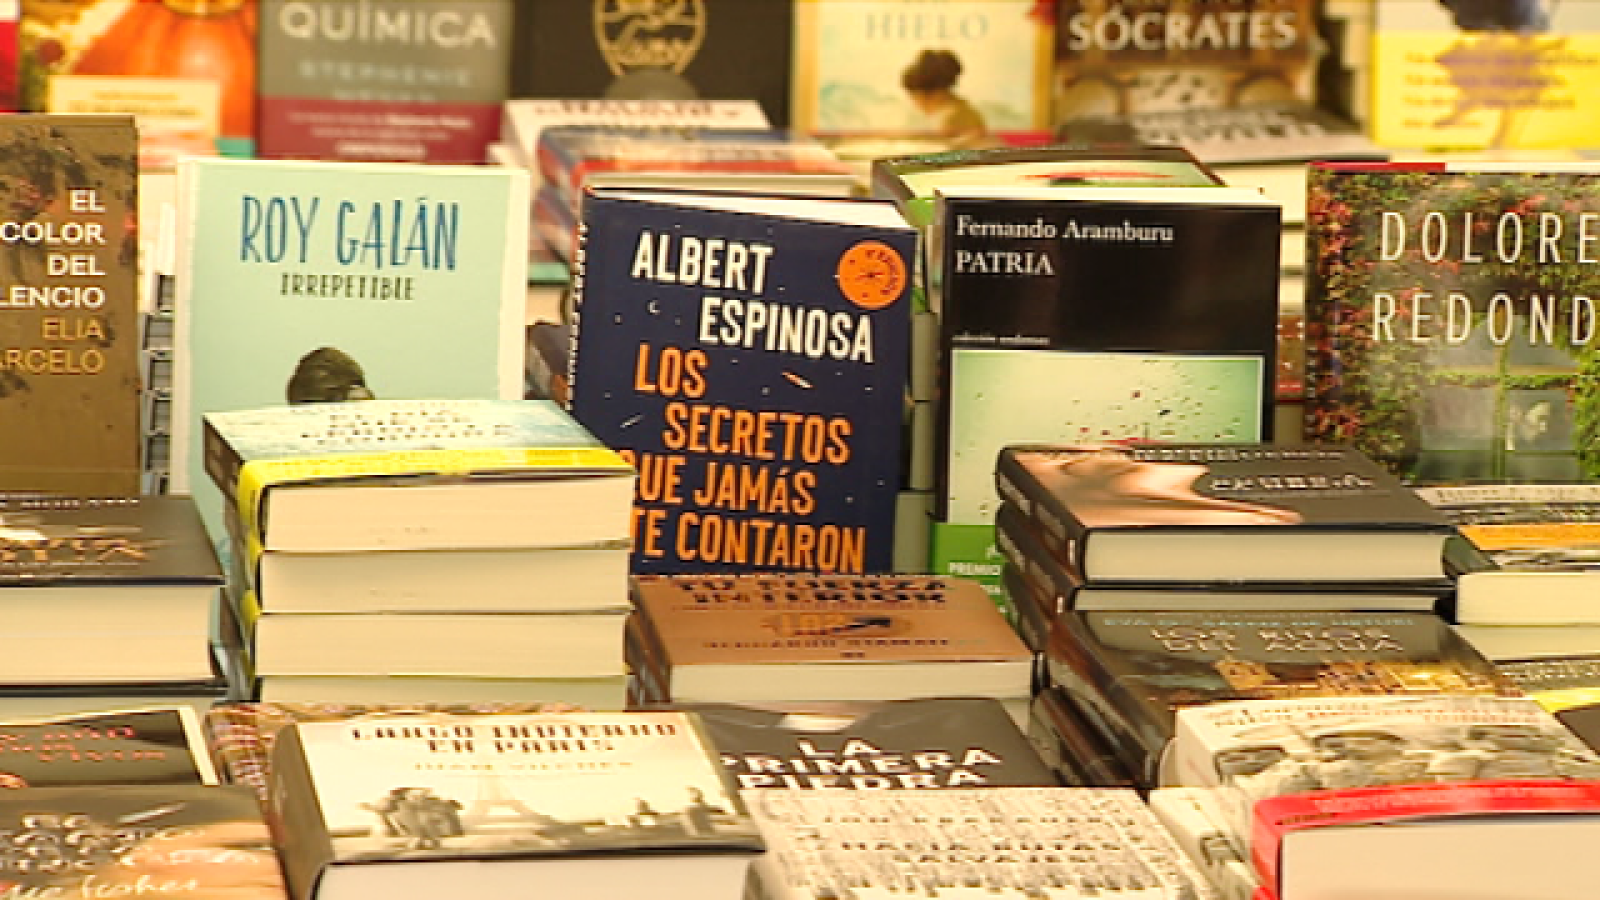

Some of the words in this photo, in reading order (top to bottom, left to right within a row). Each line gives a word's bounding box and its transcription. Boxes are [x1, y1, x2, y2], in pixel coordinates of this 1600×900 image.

[864, 10, 990, 41] HIELO
[1068, 9, 1298, 52] SÓCRATES
[70, 189, 106, 213] EL
[0, 222, 106, 245] COLOR
[240, 193, 320, 266] ROY
[336, 197, 459, 272] GALÁN
[955, 214, 1057, 239] Fernando
[1062, 217, 1175, 242] Aramburu
[1380, 210, 1600, 264] DOLORE
[47, 254, 106, 276] DEL
[631, 229, 773, 295] ALBERT
[954, 249, 1055, 276] PATRIA
[281, 273, 415, 302] IRREPETIBLE
[42, 317, 105, 340] ELIA
[699, 296, 875, 363] ESPINOSA
[1371, 291, 1598, 346] REDOND
[634, 342, 708, 398] LOS
[662, 402, 853, 465] SECRETOS
[694, 459, 817, 516] JAMÁS
[629, 506, 668, 557] TE
[676, 512, 866, 574] CONTARON
[796, 736, 884, 757] LA
[736, 767, 988, 790] PIEDRA
